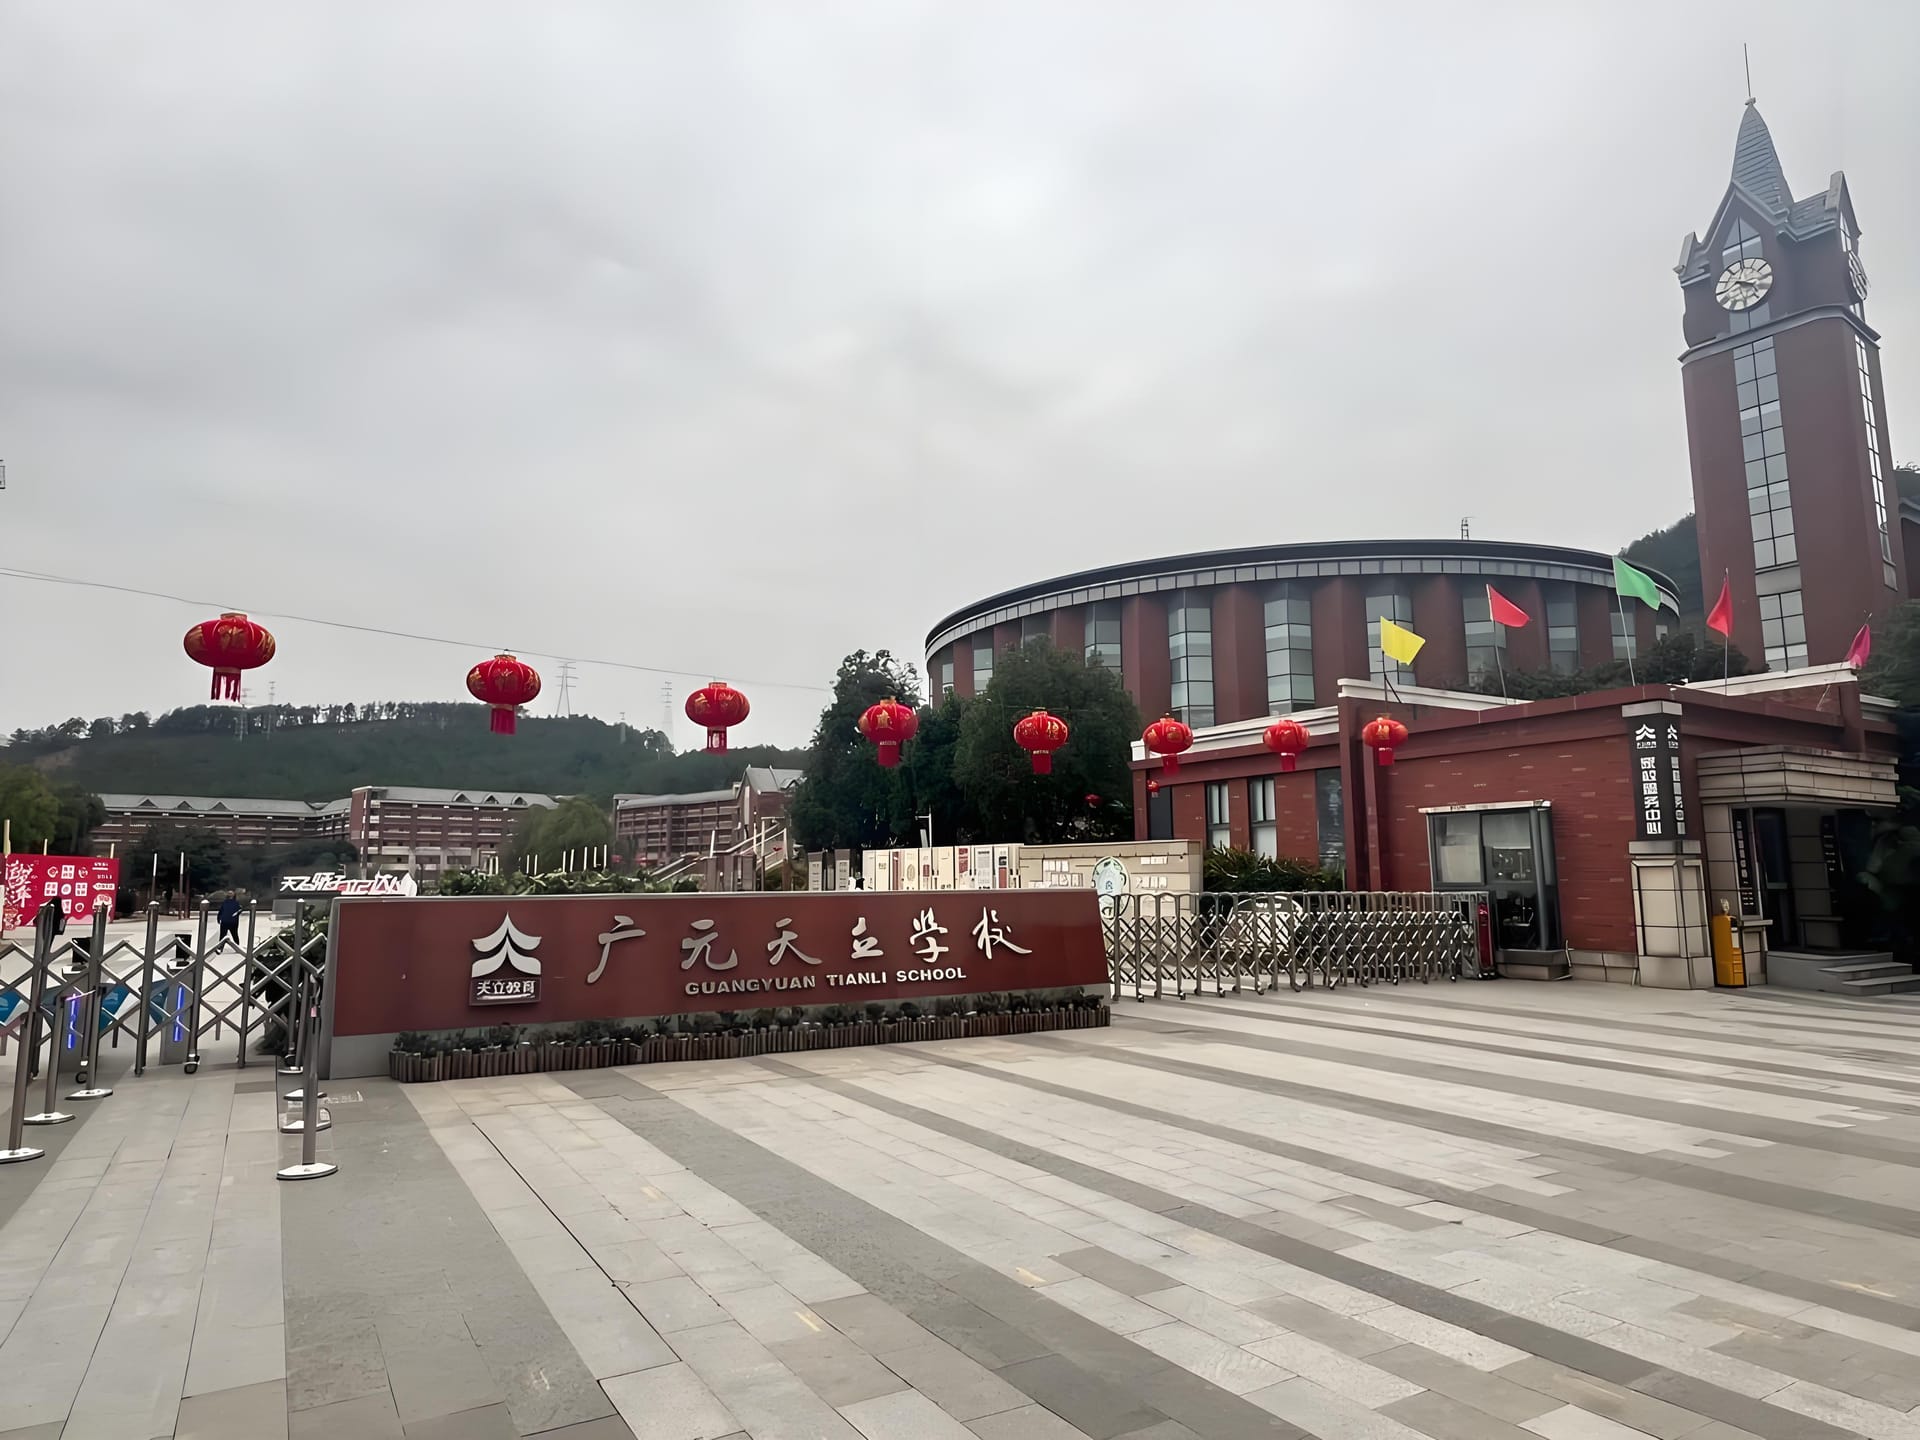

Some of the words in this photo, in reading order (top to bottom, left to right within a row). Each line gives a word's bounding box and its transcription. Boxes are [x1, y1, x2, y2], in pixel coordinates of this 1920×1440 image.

[586, 906, 1033, 984] 广元天立学校
[685, 974, 816, 996] GUANGYUAN
[826, 971, 888, 987] TIANLI
[896, 967, 967, 983] SCHOOL
